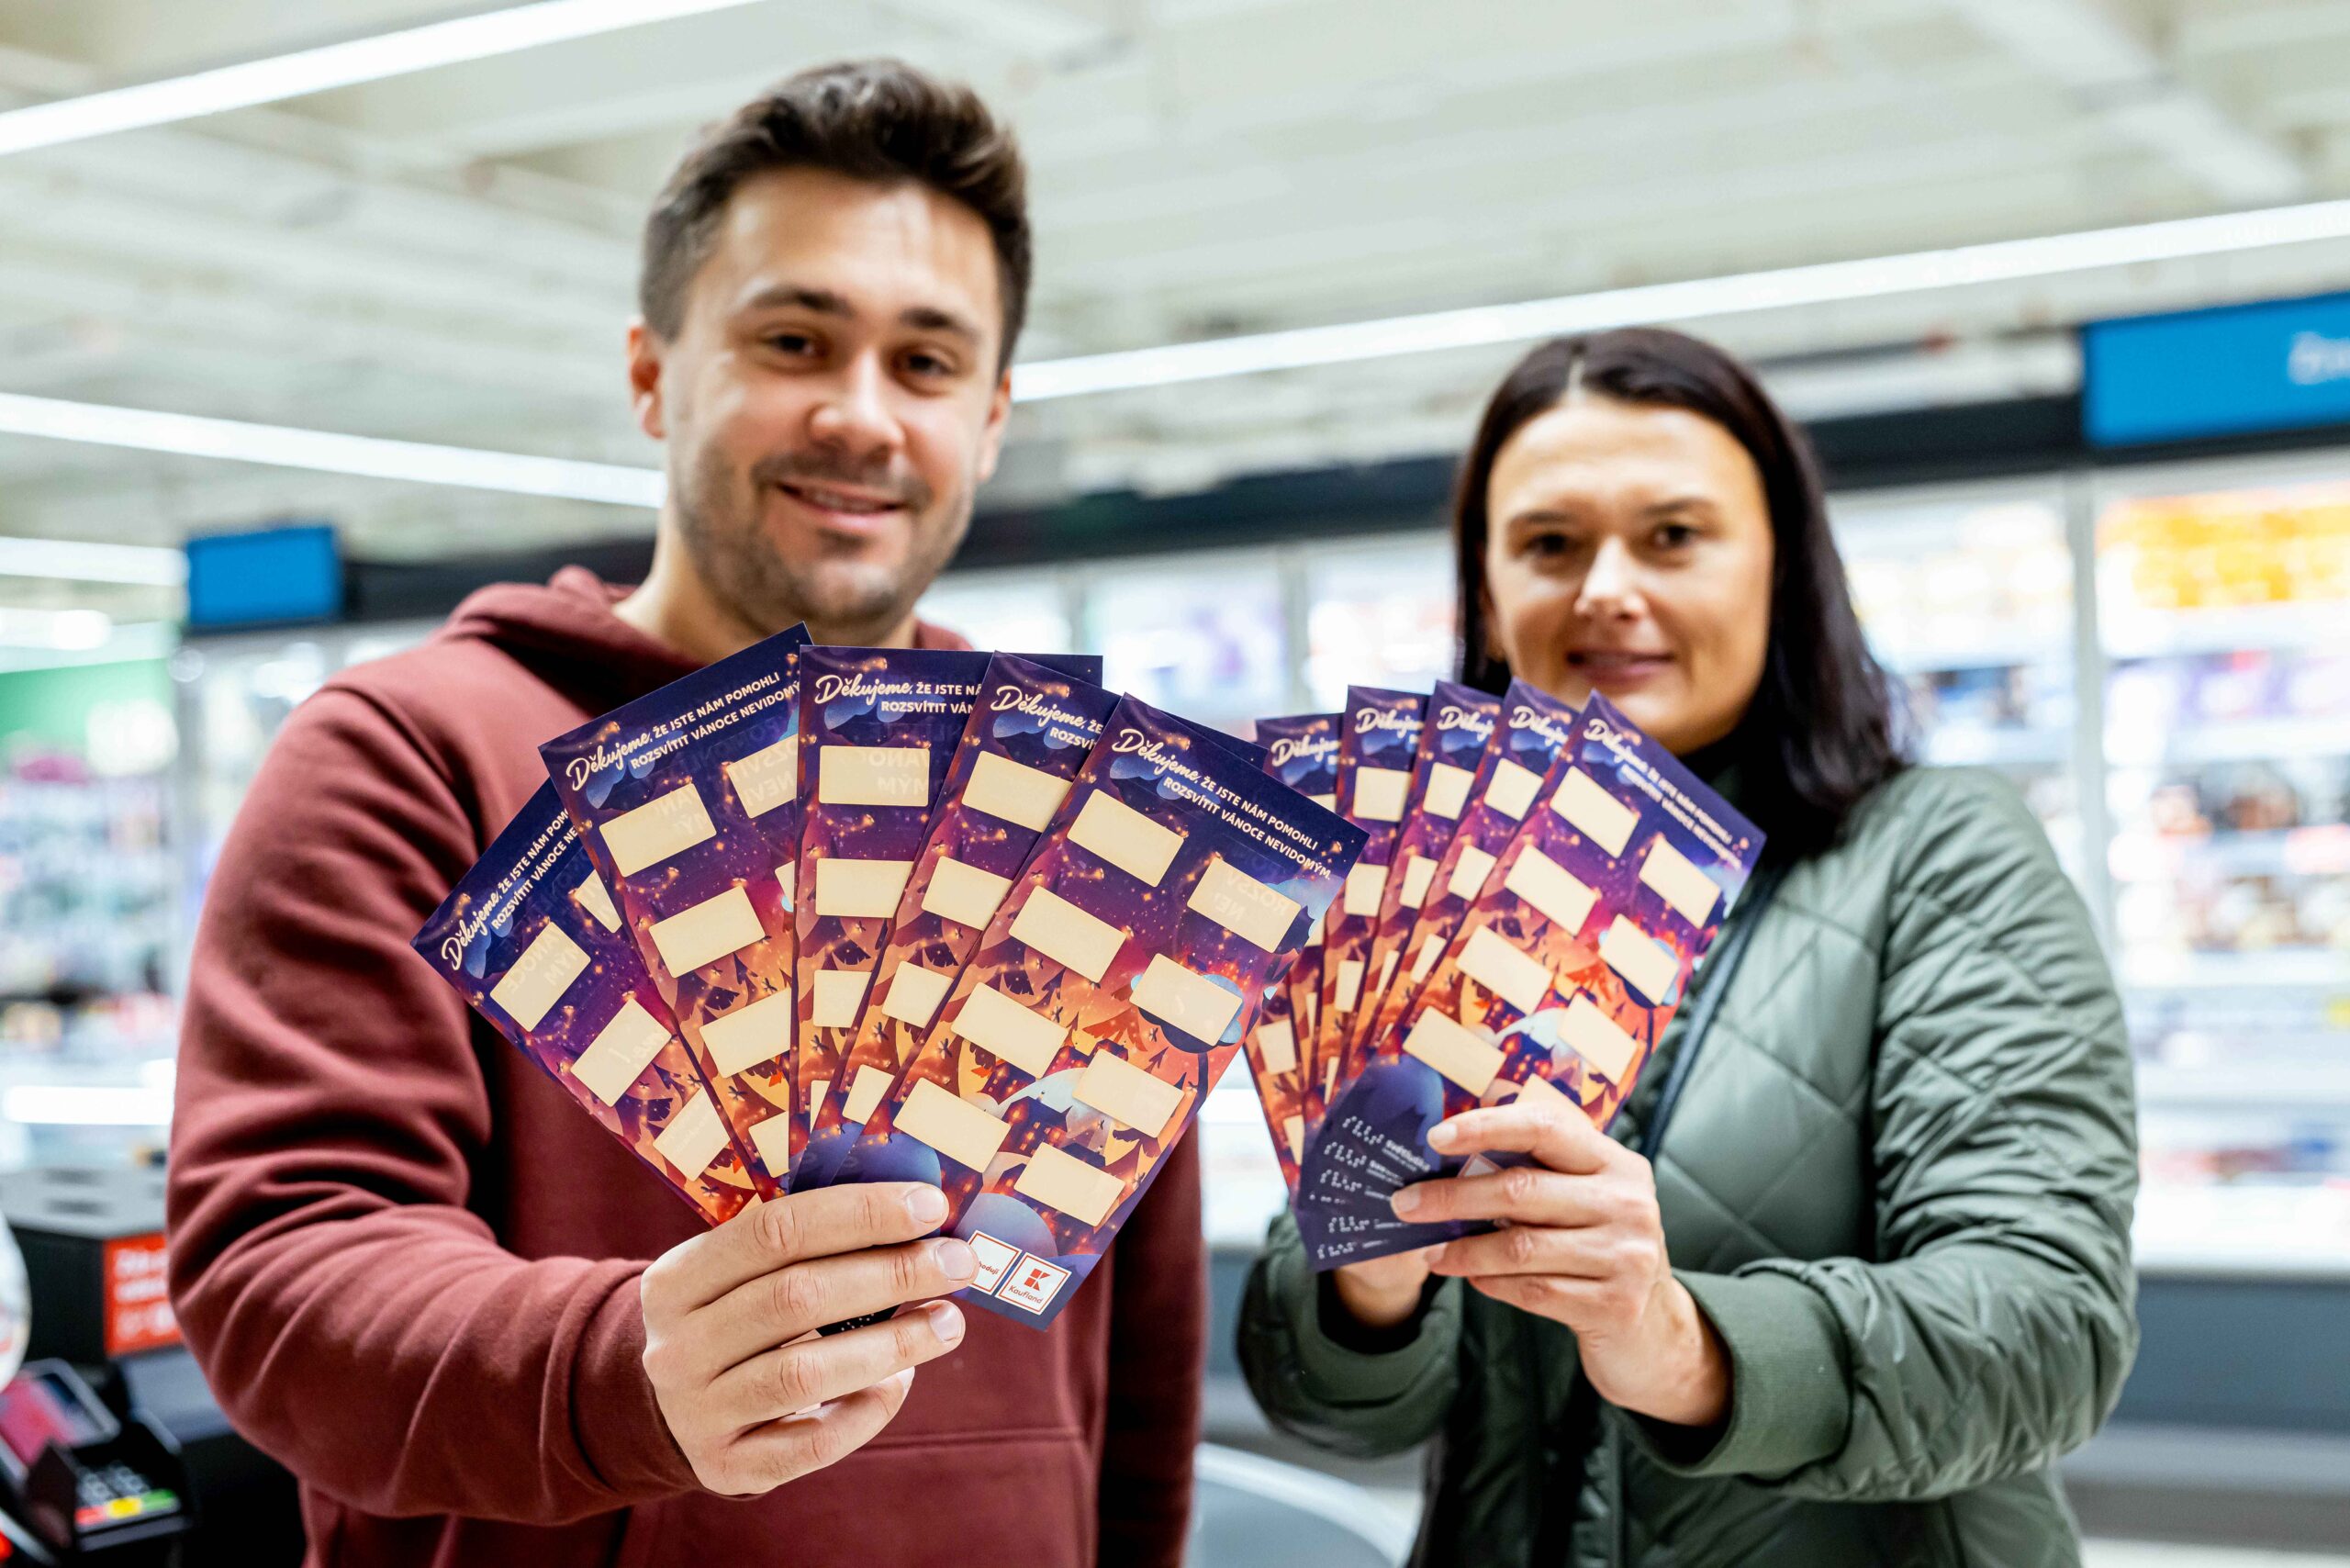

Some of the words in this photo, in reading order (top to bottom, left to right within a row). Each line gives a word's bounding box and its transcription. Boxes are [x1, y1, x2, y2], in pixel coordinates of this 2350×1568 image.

[652, 723, 669, 739] ŽE
[669, 711, 696, 731] JSTE
[696, 697, 725, 718] NÁM
[725, 671, 780, 705] POMOHLI
[881, 700, 947, 714] ROZSVÍTIT
[915, 681, 931, 695] ŽE
[934, 684, 963, 696] JSTE
[630, 734, 689, 769] ROZSVÍTIT
[690, 711, 739, 741] VÁNOCE
[1049, 726, 1097, 751] ROZSVÍ
[1087, 719, 1103, 734] ŽE
[1163, 777, 1220, 814] ROZSVÍTIT
[1221, 809, 1264, 842] VÁNOCE
[1264, 835, 1331, 880] NEVIDOMÝM.
[1200, 776, 1216, 792] ŽE
[1215, 787, 1241, 806] JSTE
[1241, 800, 1268, 822] NÁM
[1268, 815, 1318, 851] POMOHLI
[491, 879, 533, 930] ROZSVÍTIT
[531, 840, 567, 881] VÁNOCE
[563, 825, 578, 844] NE
[498, 877, 512, 894] ŽE
[509, 856, 531, 881] JSTE
[527, 834, 550, 859] NÁM
[1008, 1285, 1045, 1305] Kaufland
